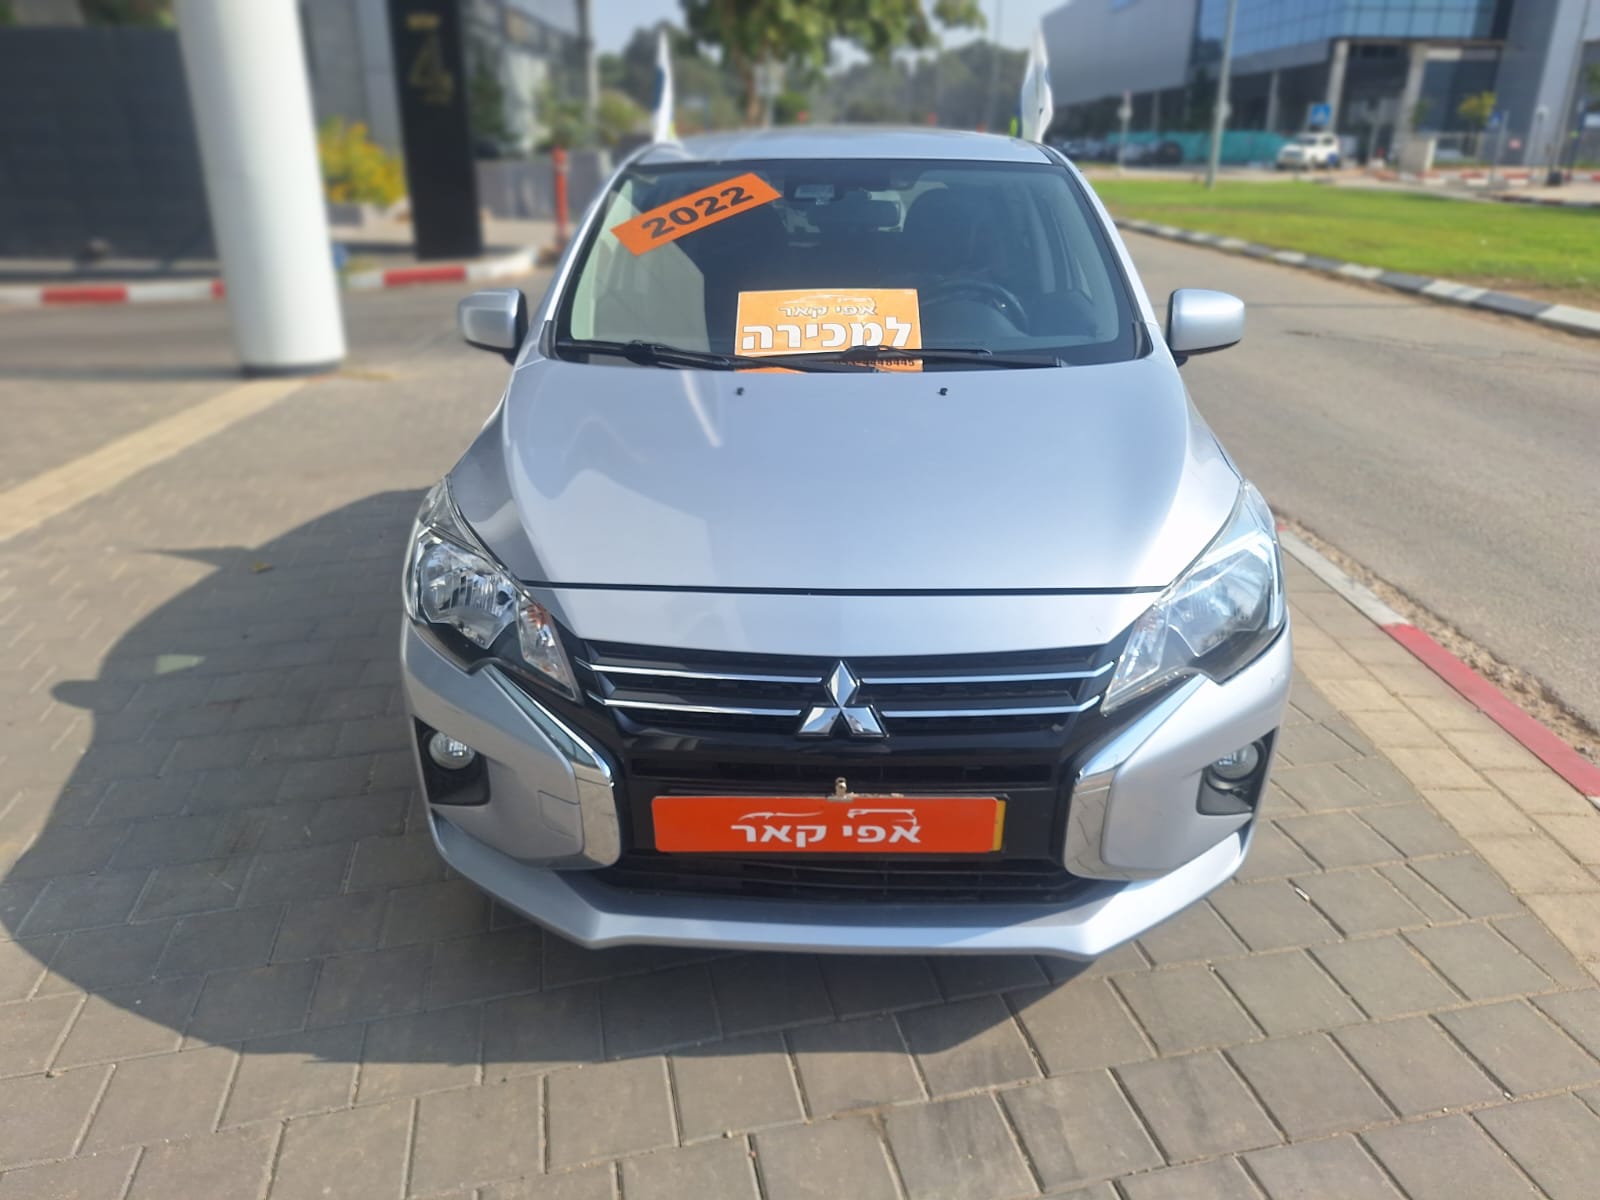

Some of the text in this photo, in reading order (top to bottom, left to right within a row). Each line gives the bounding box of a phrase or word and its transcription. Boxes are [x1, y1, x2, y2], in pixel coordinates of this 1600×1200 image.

[641, 186, 755, 239] 2022
[778, 305, 878, 318] אפי קאר
[742, 316, 912, 350] למכירה
[731, 825, 921, 848] אפי קאר
